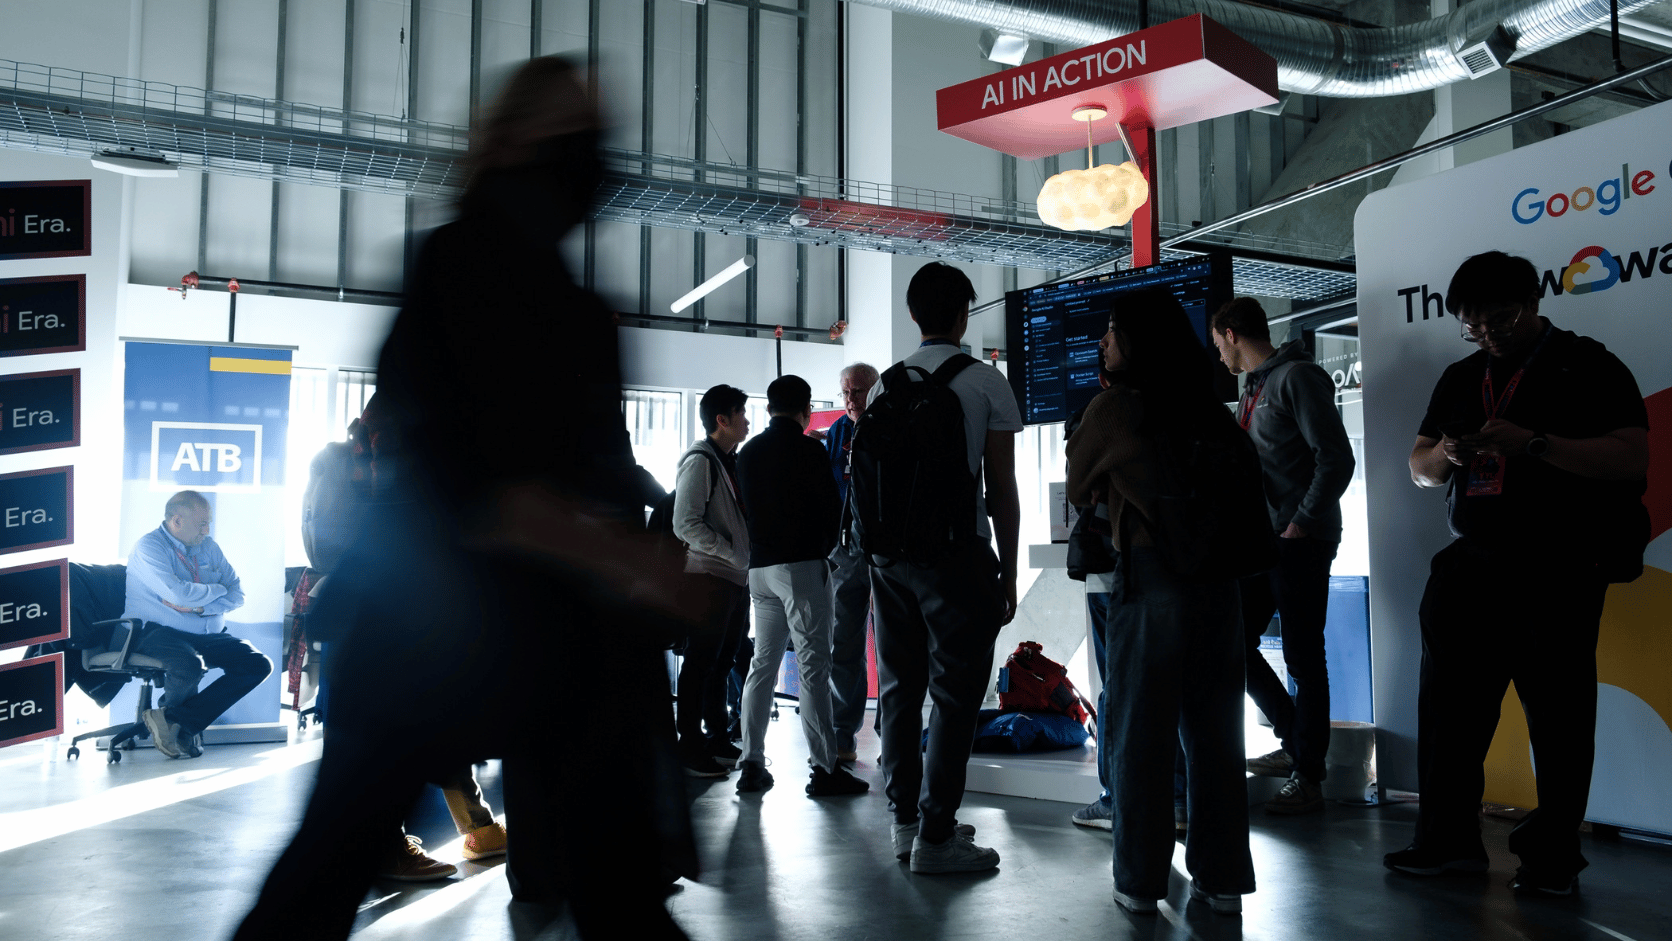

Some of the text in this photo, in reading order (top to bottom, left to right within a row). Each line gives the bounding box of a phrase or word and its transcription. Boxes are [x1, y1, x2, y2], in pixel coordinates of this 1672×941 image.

[981, 39, 1146, 109] AI IN ACTION
[1511, 162, 1656, 225] Google
[24, 214, 71, 234] Era.
[1397, 284, 1445, 323] Th
[18, 310, 66, 331] Era.
[1318, 354, 1348, 366] POWERED
[12, 407, 60, 428] Era.
[170, 442, 242, 473] ATB
[5, 506, 54, 528] Era.
[0, 602, 48, 624] Era.
